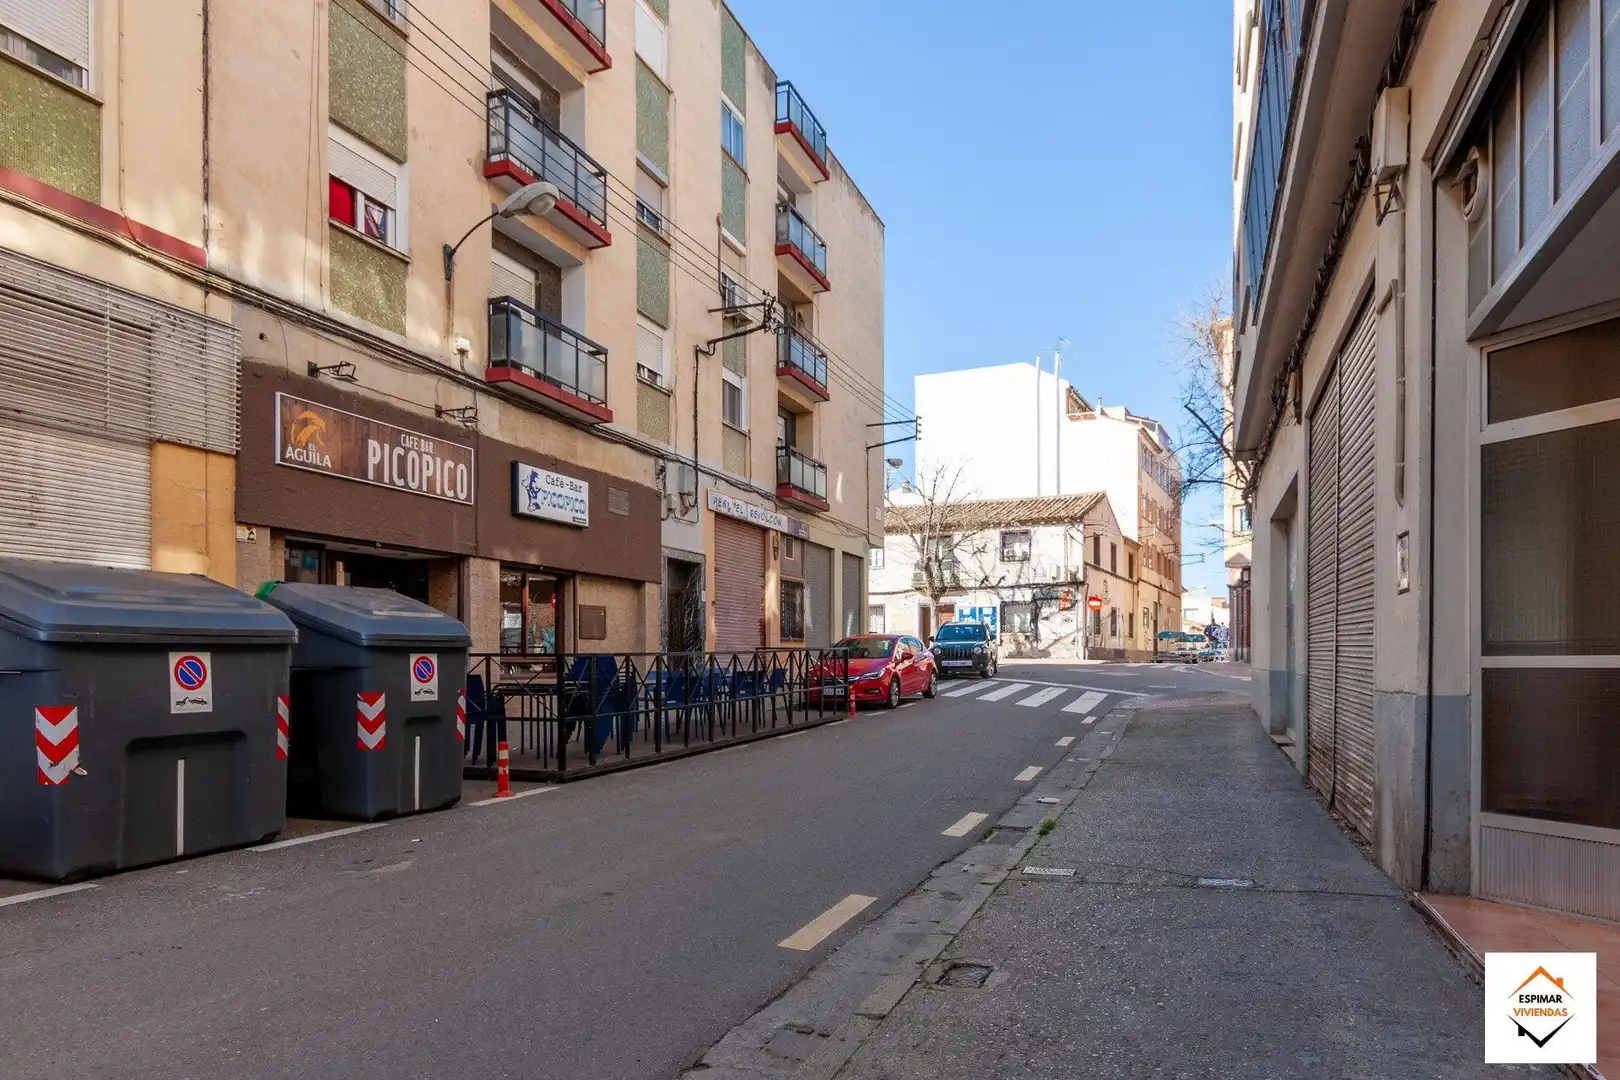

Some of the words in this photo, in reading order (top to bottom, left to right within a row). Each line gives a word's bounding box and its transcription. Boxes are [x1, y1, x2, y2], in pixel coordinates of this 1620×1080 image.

[285, 443, 332, 469] ÁGUILA
[308, 443, 317, 452] EL
[400, 433, 418, 451] CAFE
[420, 436, 434, 455] BAR
[367, 438, 468, 500] PICOPICO
[540, 489, 587, 515] PICOPICO
